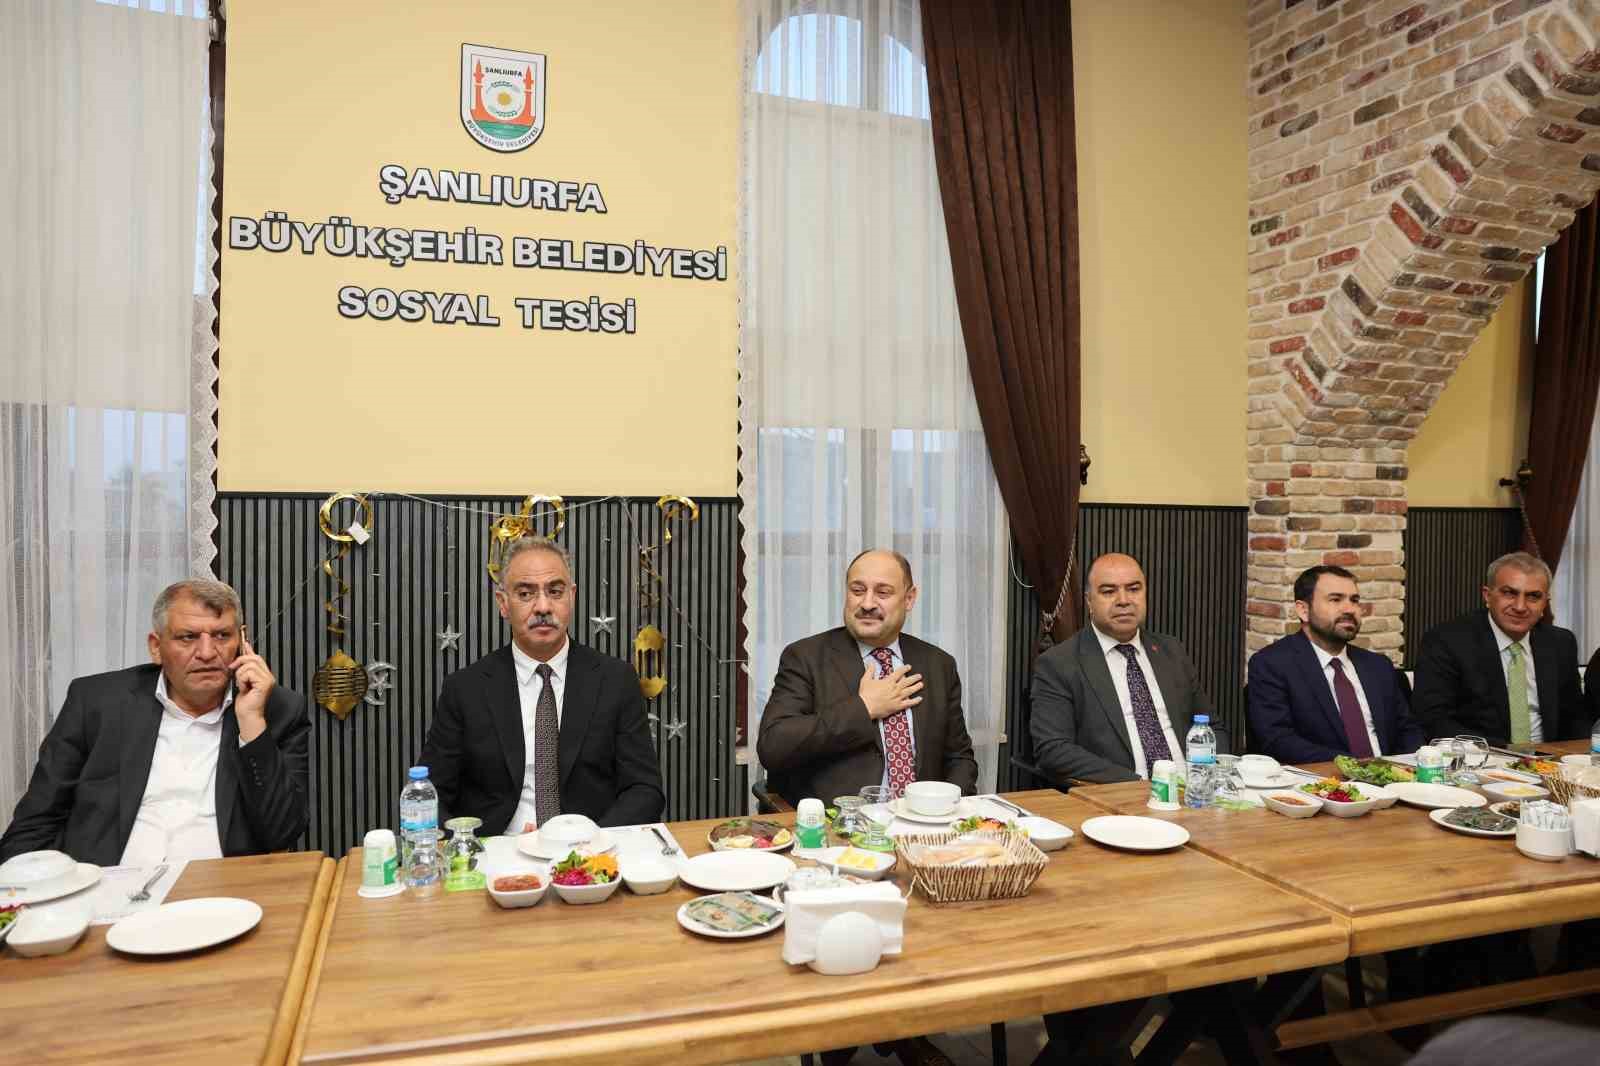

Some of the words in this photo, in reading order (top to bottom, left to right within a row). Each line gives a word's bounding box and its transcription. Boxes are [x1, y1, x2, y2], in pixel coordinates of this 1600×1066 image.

[379, 165, 607, 213] ŞANLIURFA
[229, 211, 503, 266] BÜYÜKŞEHİR
[513, 238, 728, 280] BELEDİYESİ
[337, 286, 500, 326] SOSYAL
[515, 296, 636, 334] TESİSİ
